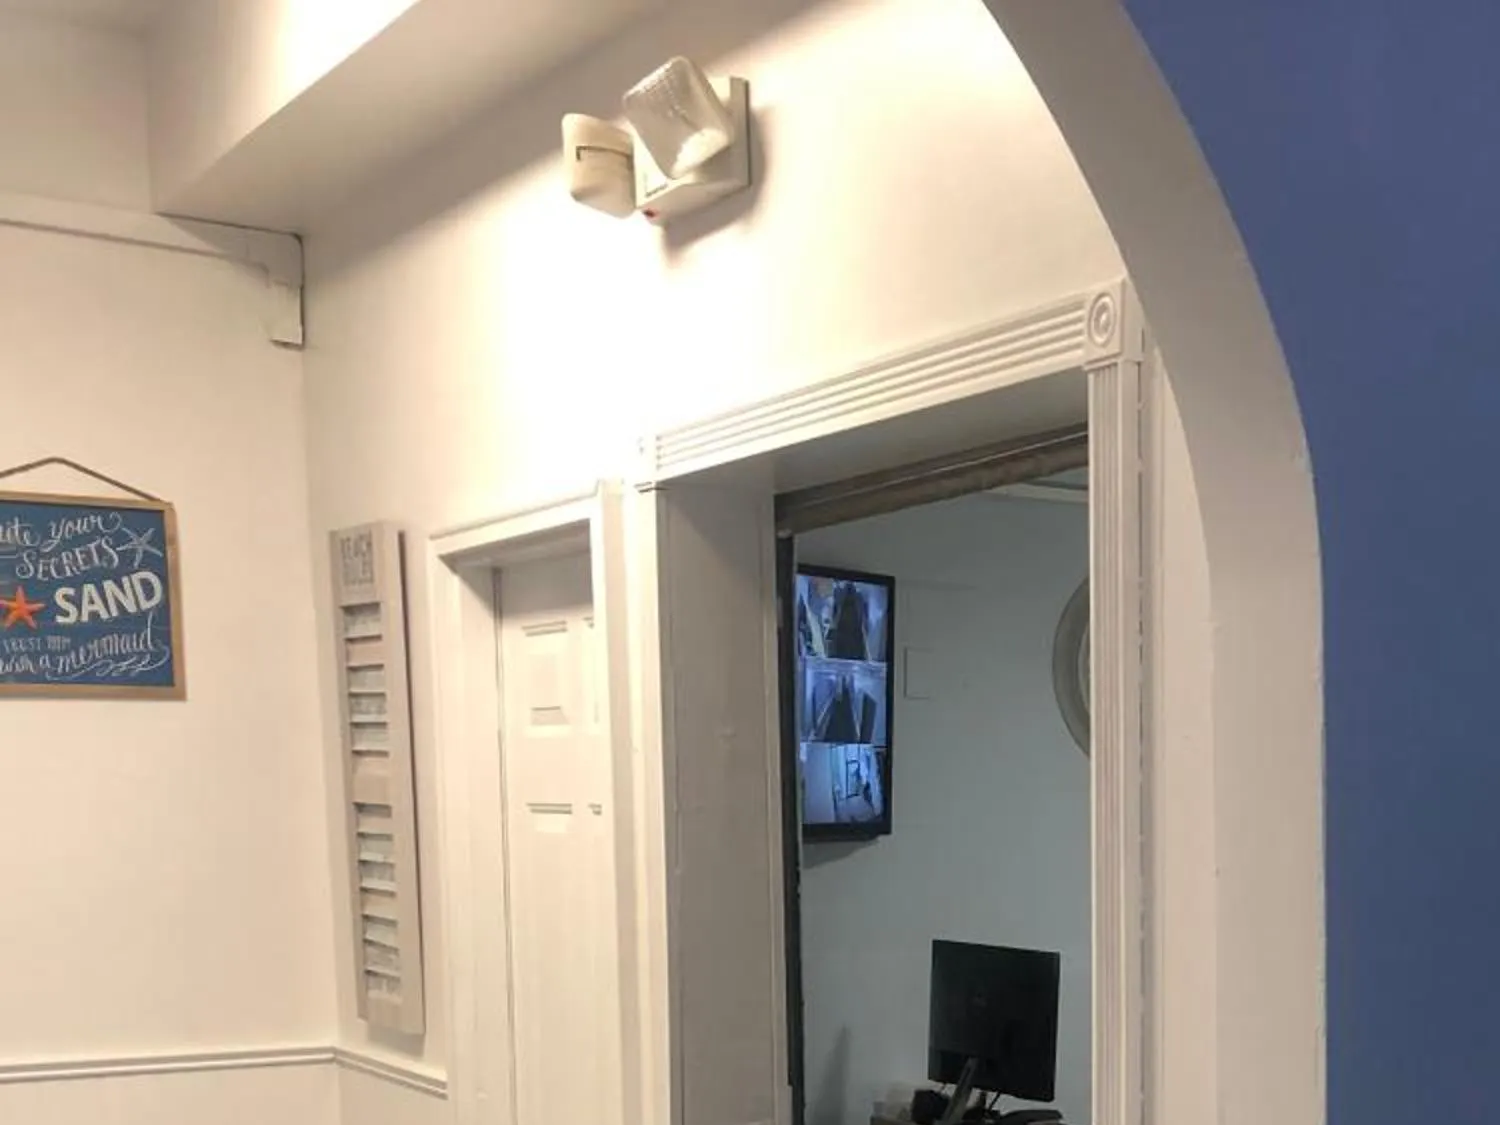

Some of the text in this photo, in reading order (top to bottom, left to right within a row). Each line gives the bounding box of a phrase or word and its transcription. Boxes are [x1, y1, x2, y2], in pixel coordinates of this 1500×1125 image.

[42, 512, 121, 551] your
[16, 538, 119, 581] SECRETS
[54, 571, 163, 624] SAND
[56, 611, 154, 674] mermaid
